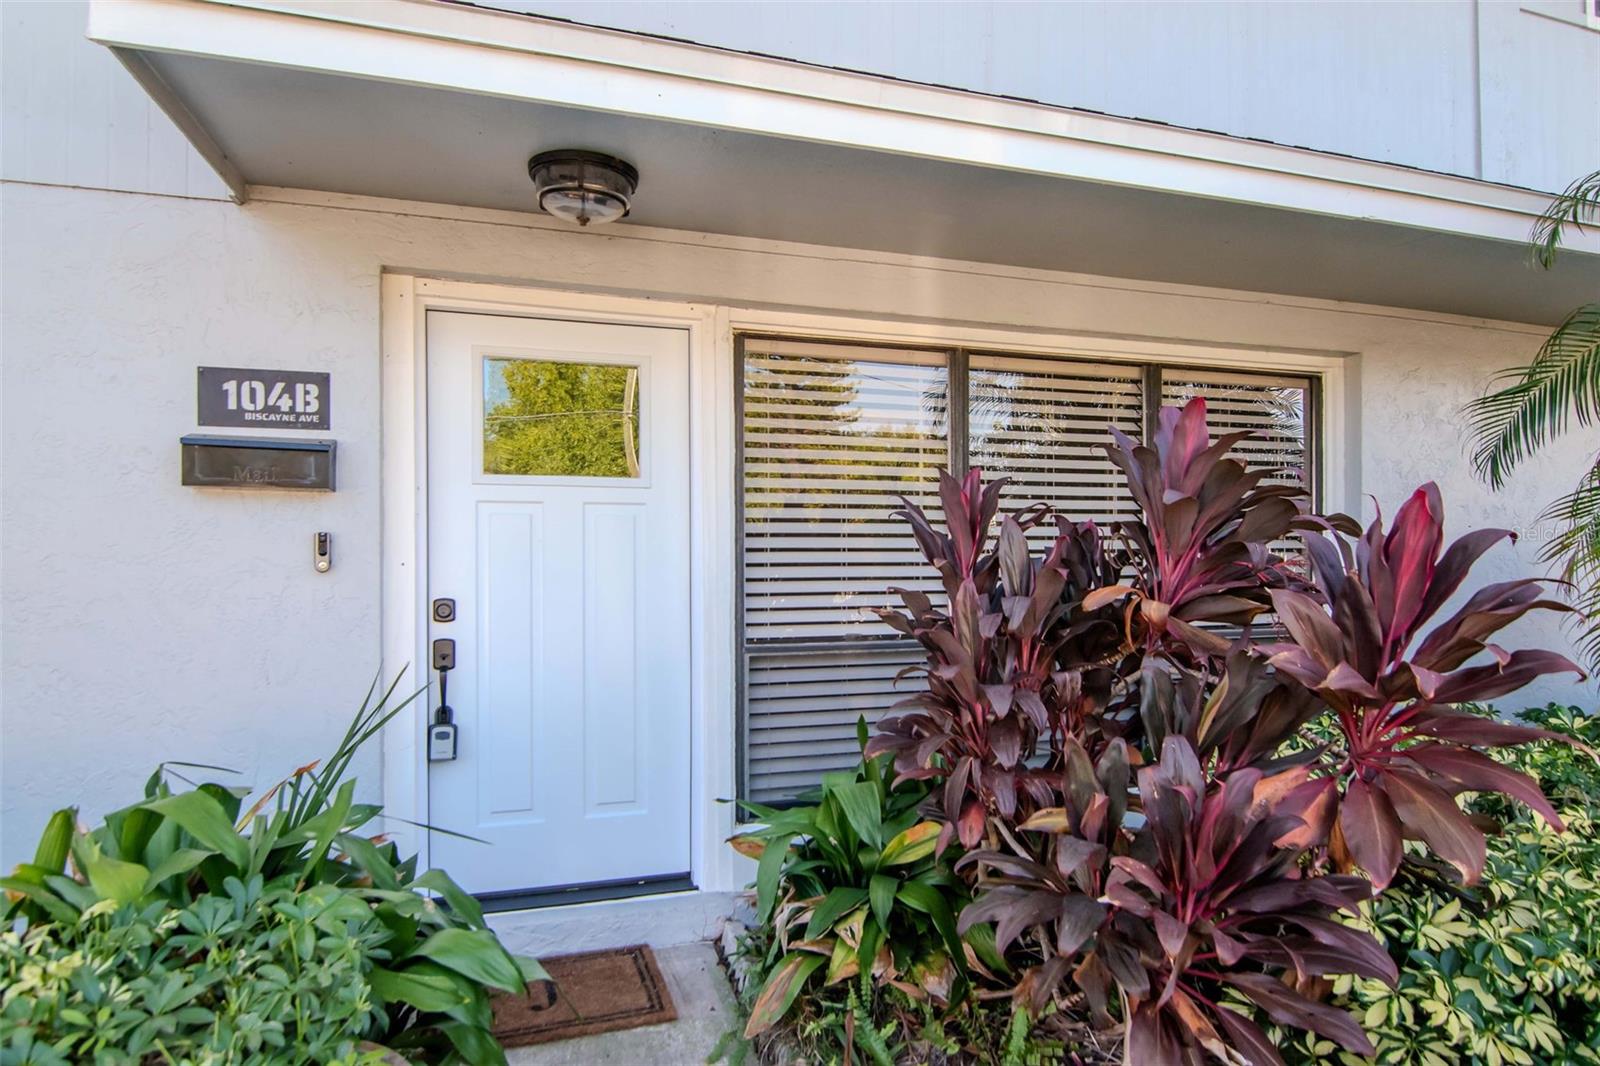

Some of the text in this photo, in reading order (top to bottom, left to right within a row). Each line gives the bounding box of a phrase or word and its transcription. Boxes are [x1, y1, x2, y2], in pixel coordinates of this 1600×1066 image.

[222, 380, 319, 412] 104B
[244, 413, 319, 423] BISCAYNE AVE
[232, 465, 280, 482] Mail
